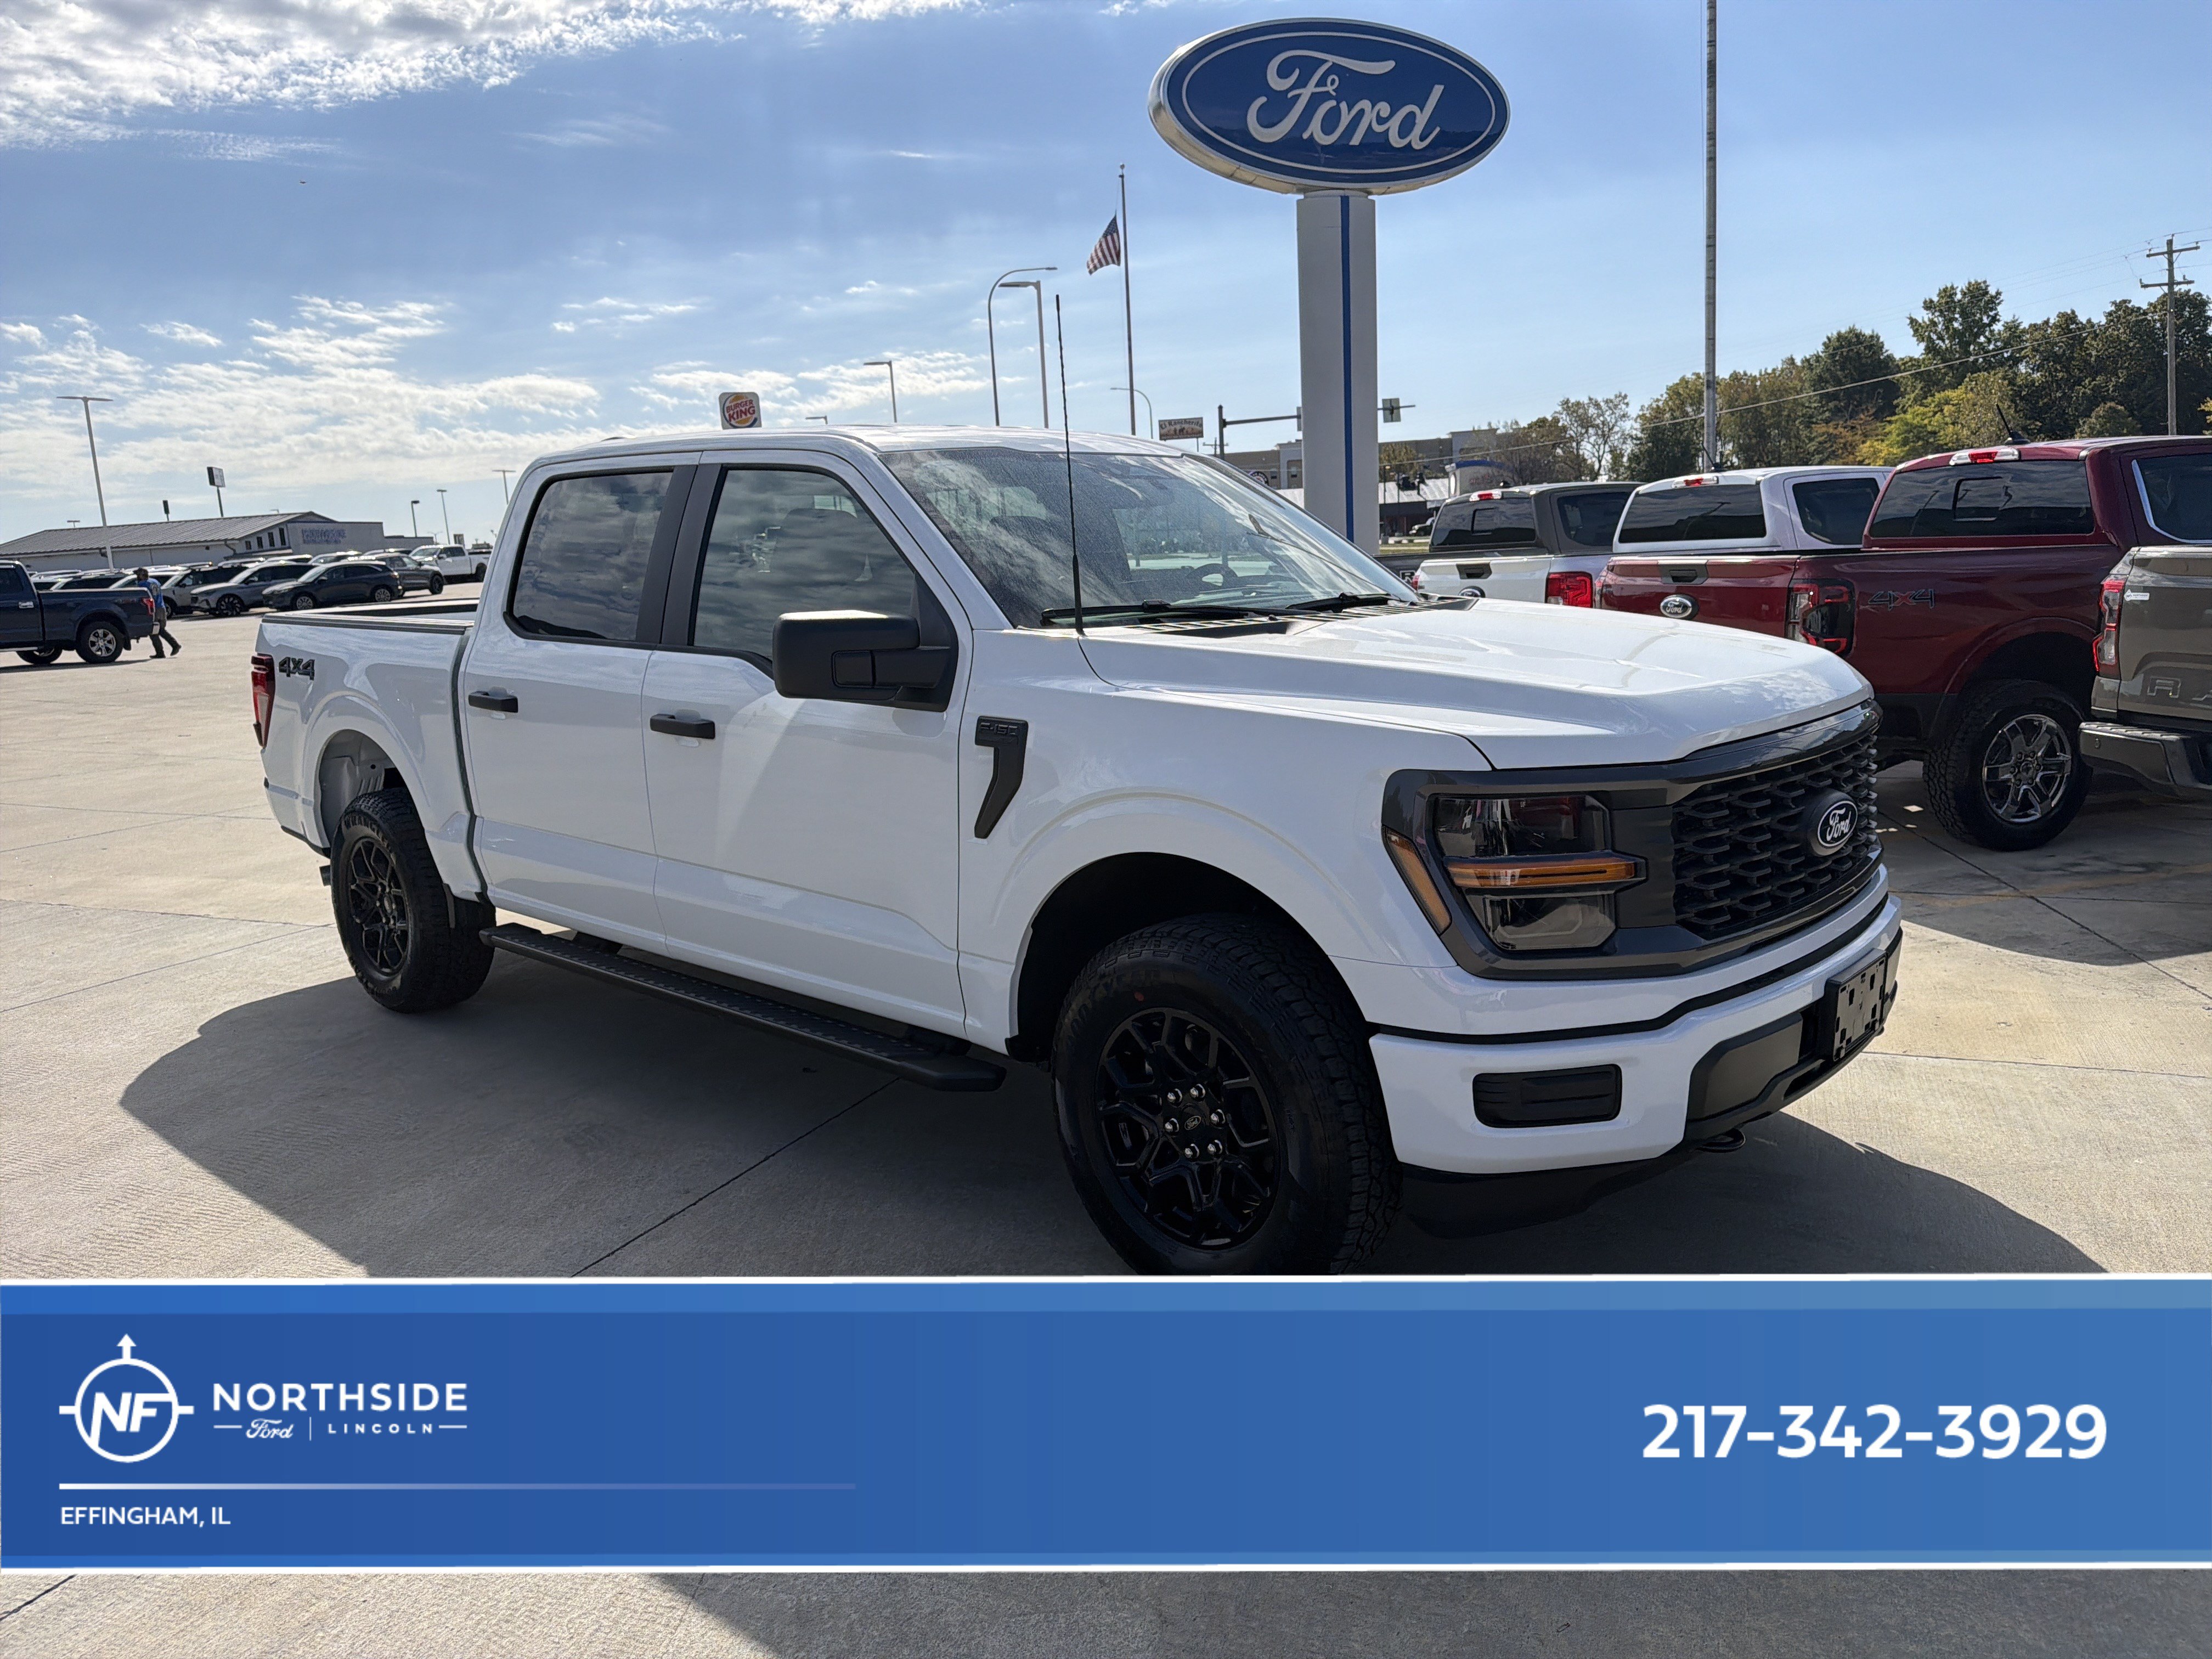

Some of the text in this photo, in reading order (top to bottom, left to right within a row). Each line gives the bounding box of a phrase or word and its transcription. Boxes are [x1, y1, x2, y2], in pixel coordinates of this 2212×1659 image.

[1247, 49, 1444, 150] Ford
[726, 399, 754, 413] BURGER
[728, 406, 756, 422] KING
[1666, 601, 1684, 613] Ford
[1826, 807, 1852, 841] Ford
